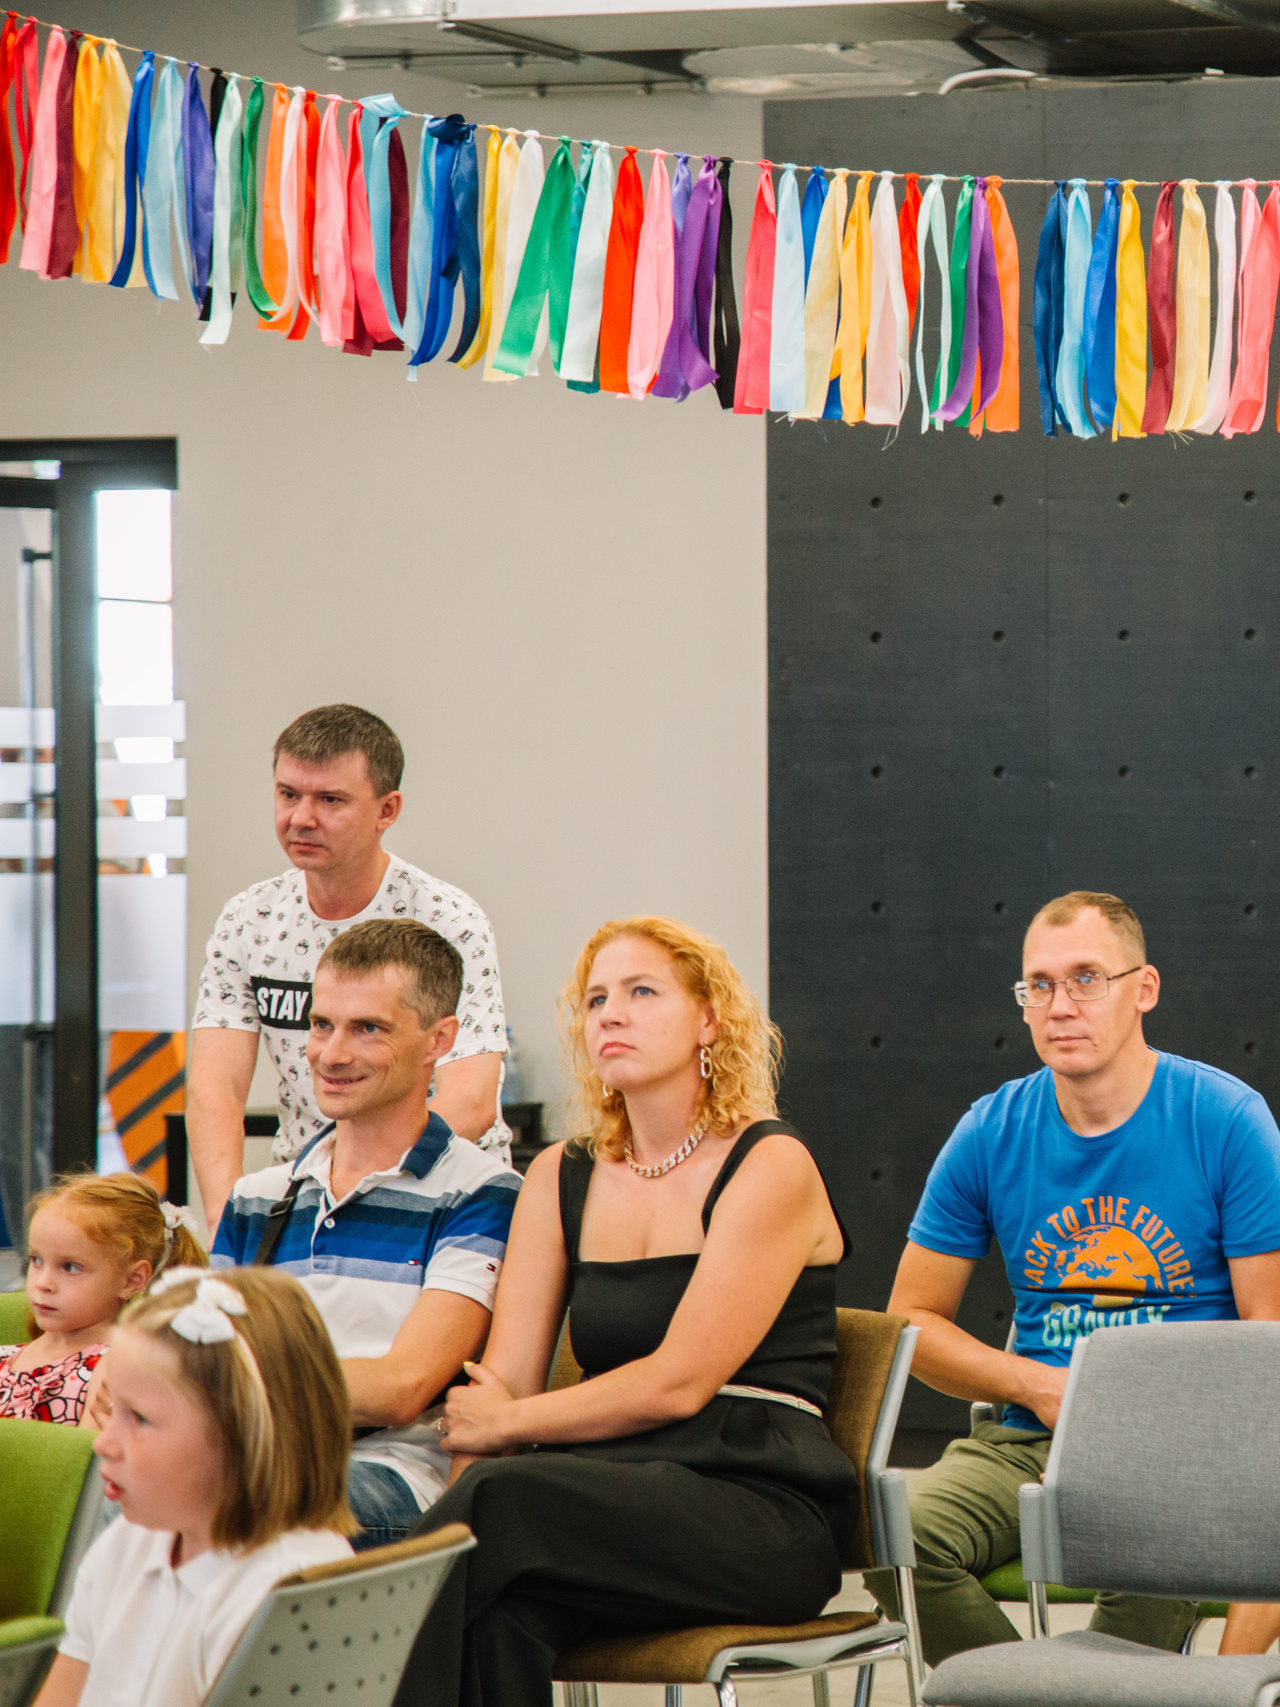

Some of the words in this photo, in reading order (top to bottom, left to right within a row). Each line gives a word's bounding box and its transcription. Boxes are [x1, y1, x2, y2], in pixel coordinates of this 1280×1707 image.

[256, 986, 310, 1021] STAY
[1046, 1205, 1080, 1240] TO
[1081, 1195, 1130, 1226] THE
